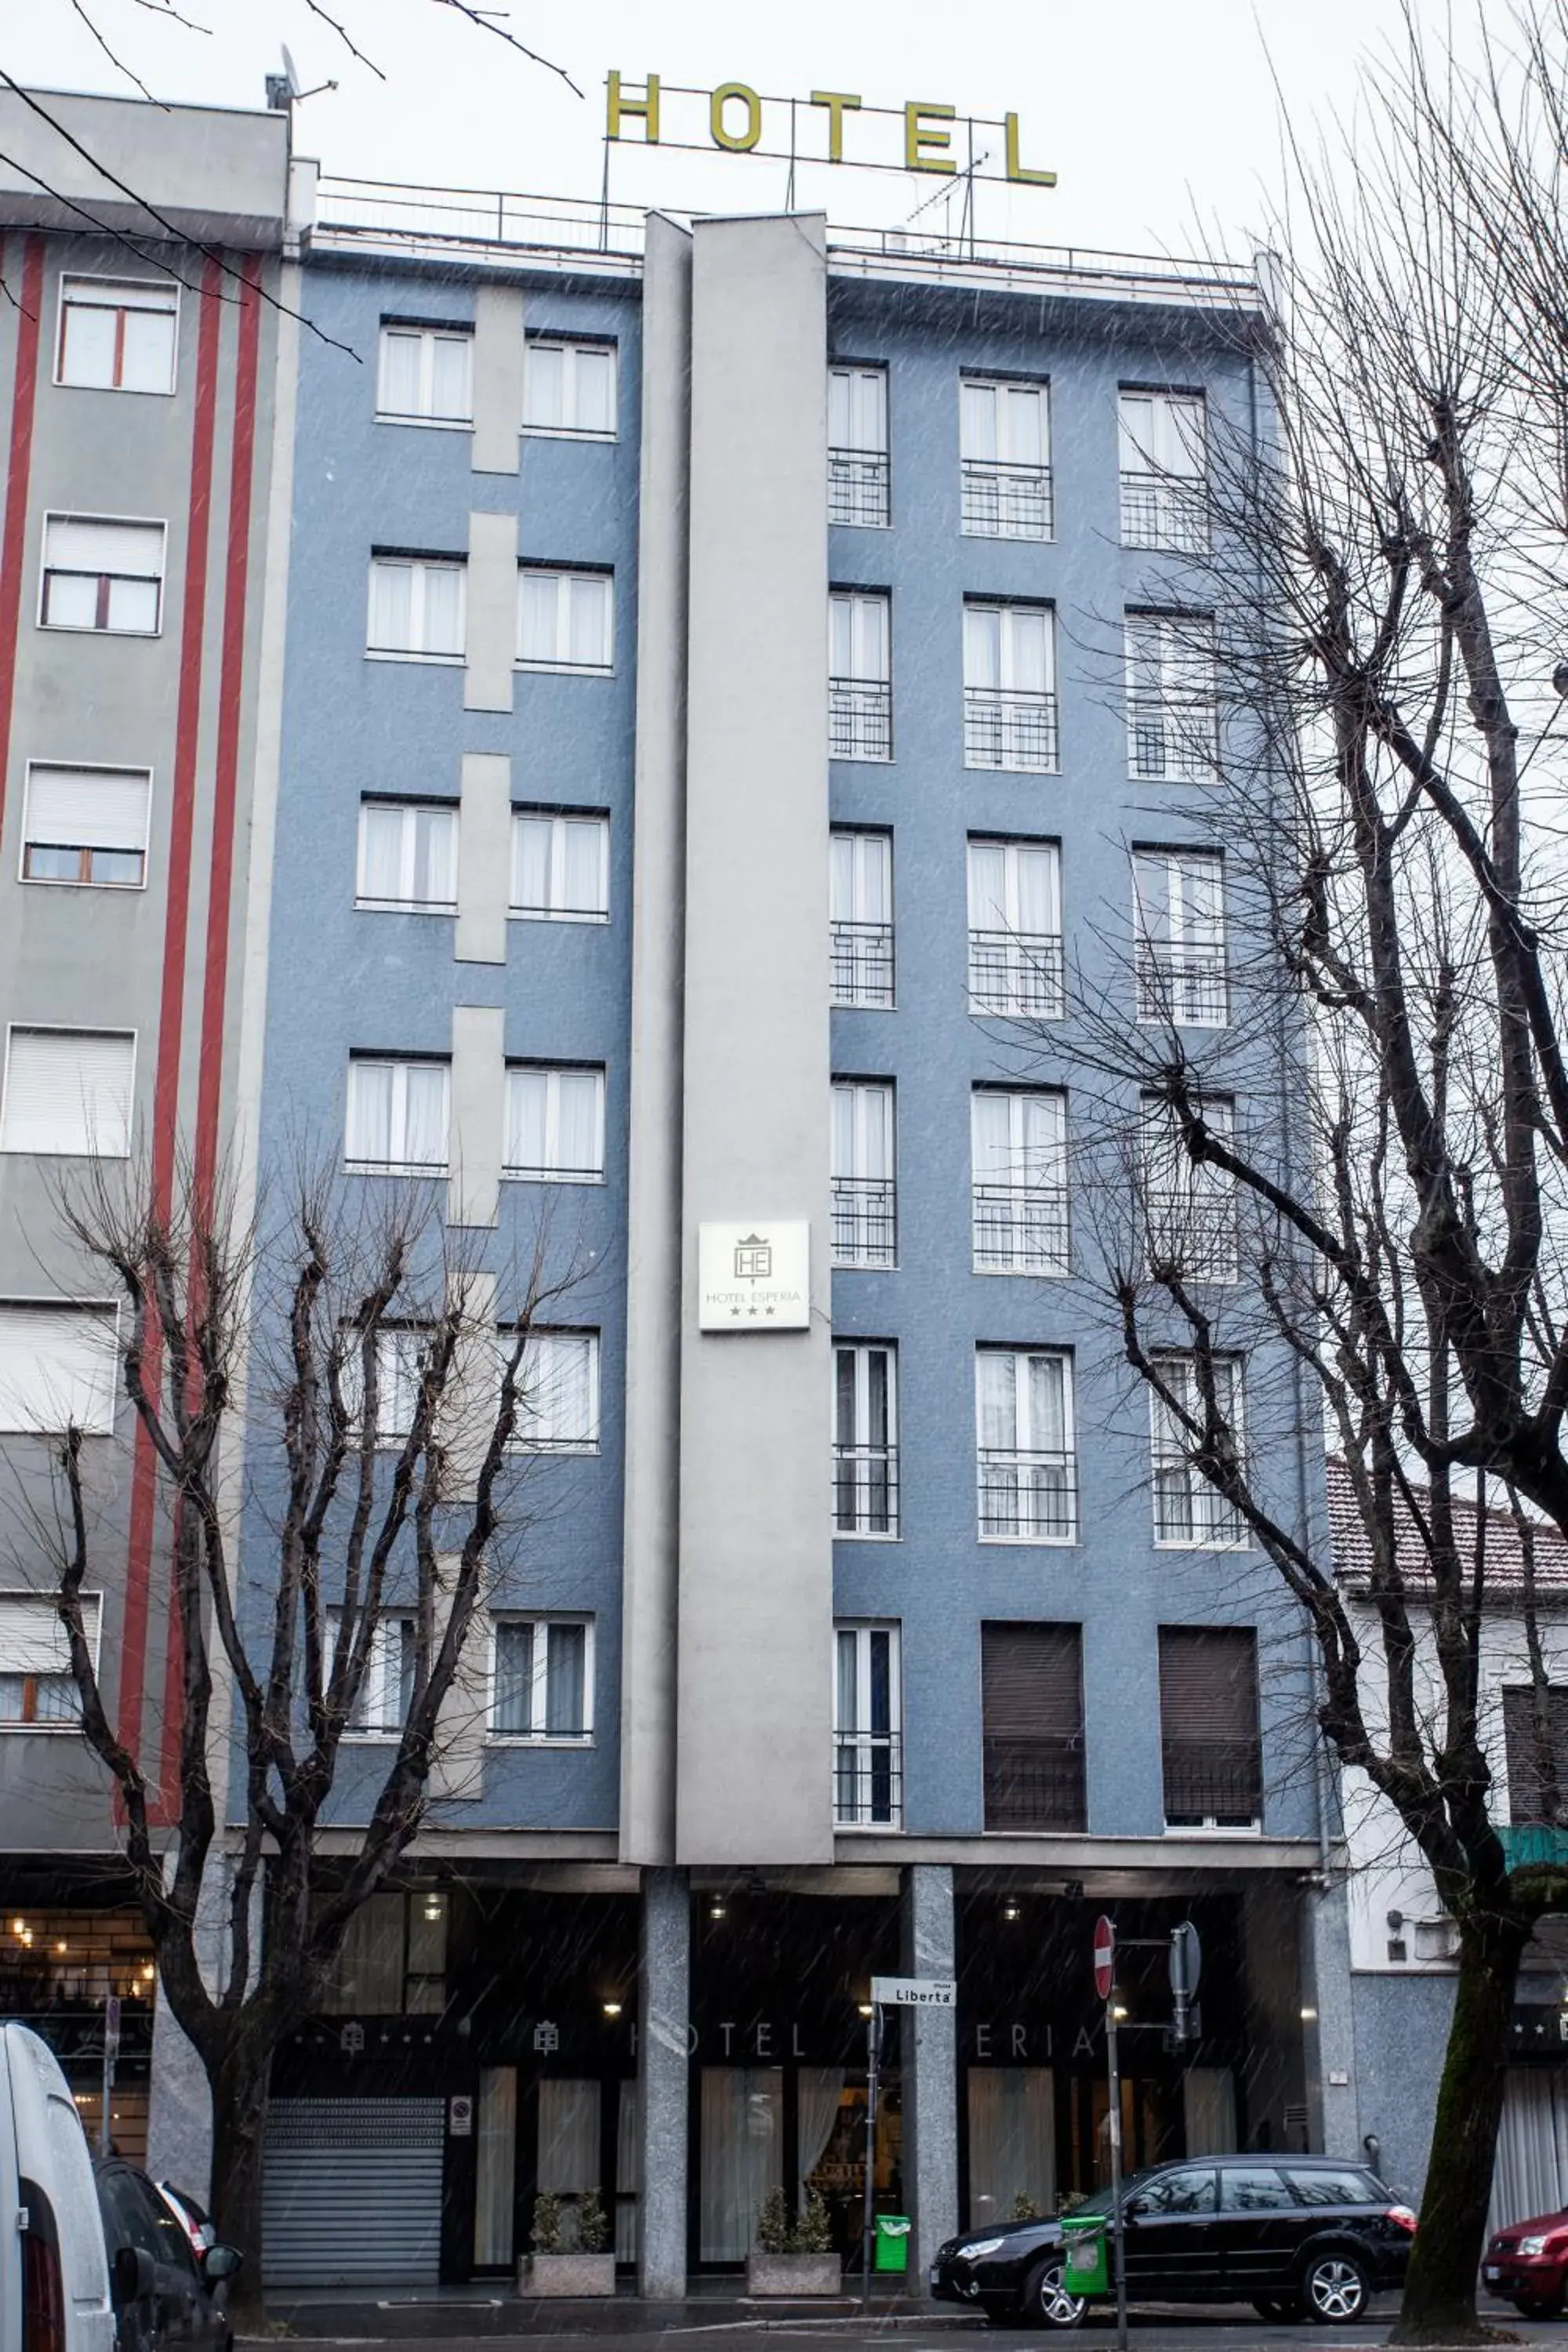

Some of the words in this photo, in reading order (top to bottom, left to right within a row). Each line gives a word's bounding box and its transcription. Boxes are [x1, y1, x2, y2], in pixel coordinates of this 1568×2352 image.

[606, 69, 1058, 188] HOTEL
[706, 1292, 745, 1304] HOTEL
[751, 1290, 801, 1303] ESPERIA
